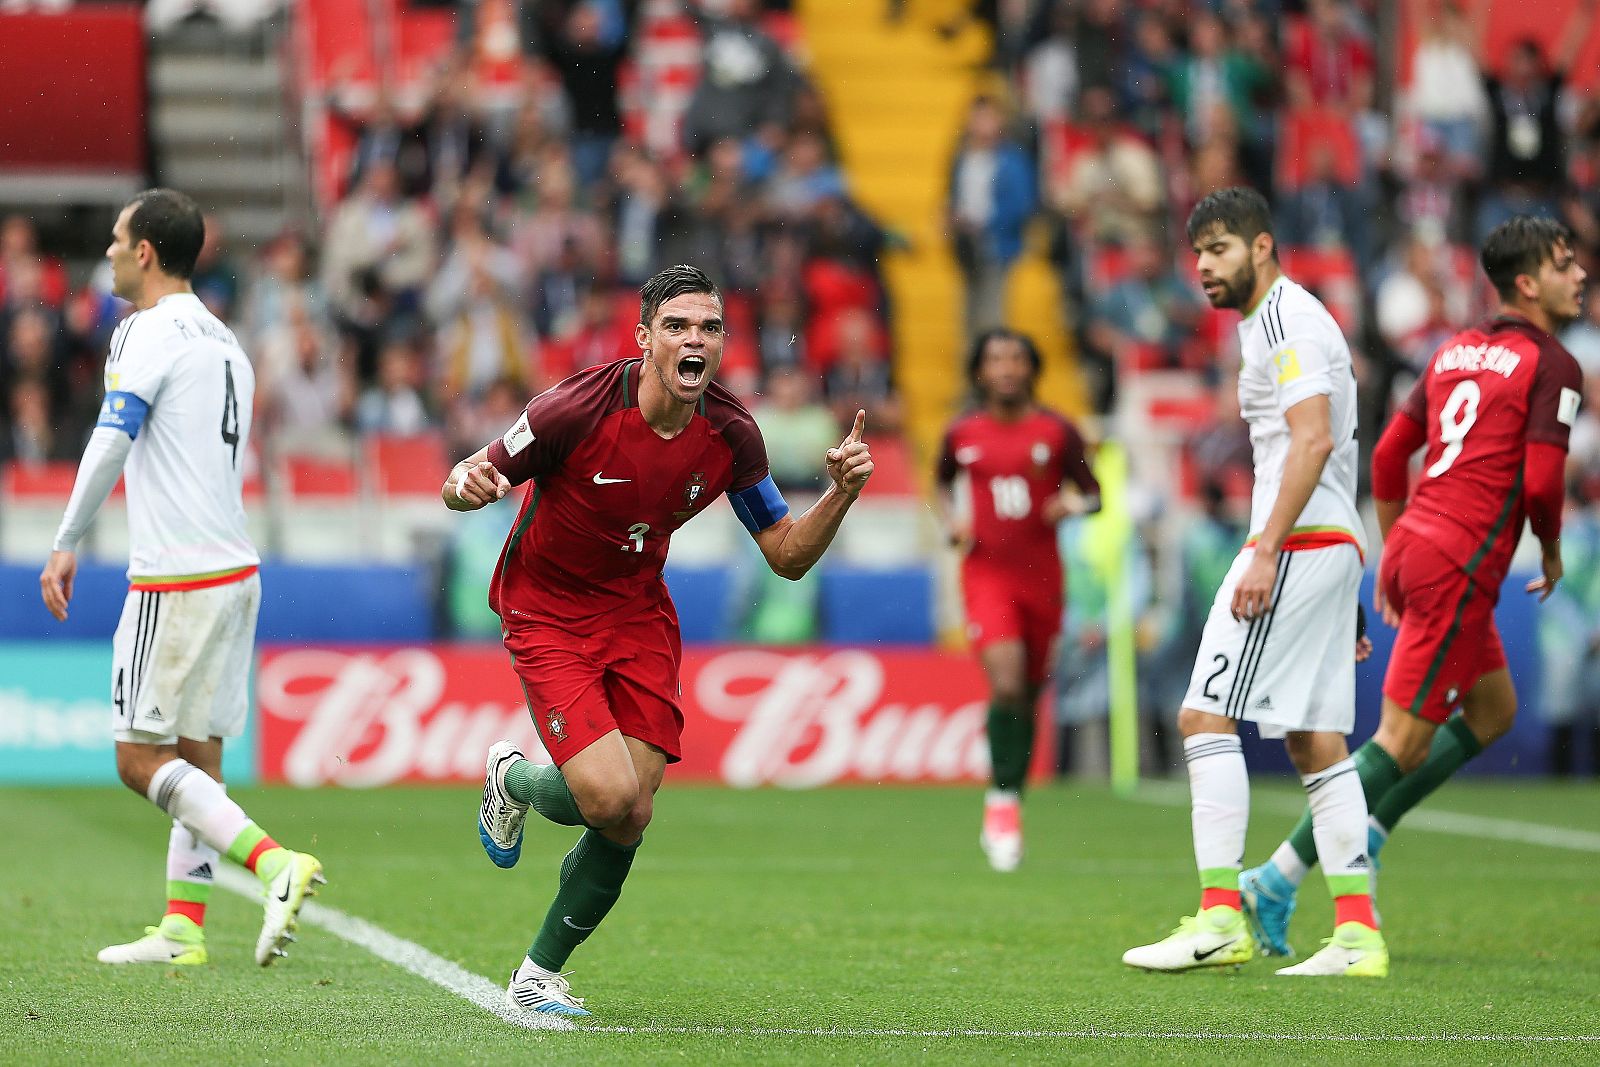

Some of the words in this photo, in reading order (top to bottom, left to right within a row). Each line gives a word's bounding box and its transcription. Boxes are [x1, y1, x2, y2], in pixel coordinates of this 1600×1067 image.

[221, 359, 239, 472] 4
[1426, 379, 1481, 478] 9
[620, 522, 650, 553] 3
[114, 667, 124, 716] 4
[1203, 653, 1229, 702] 2
